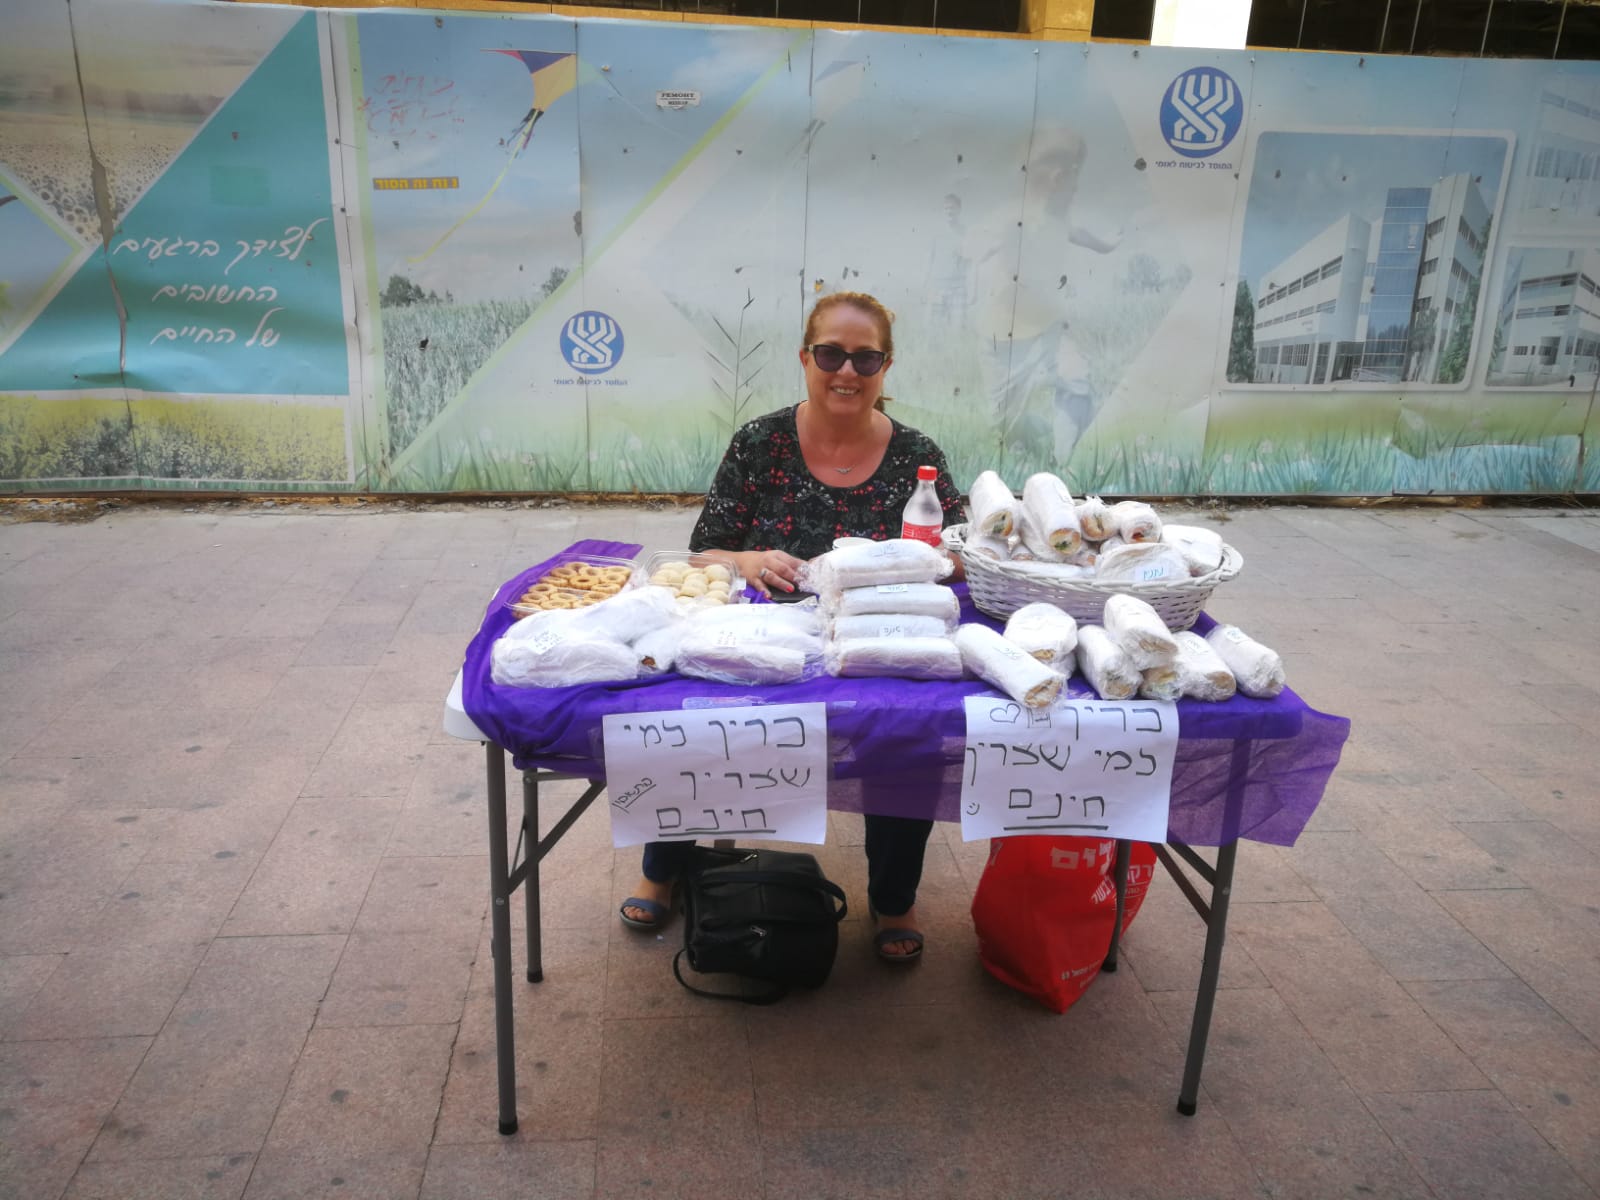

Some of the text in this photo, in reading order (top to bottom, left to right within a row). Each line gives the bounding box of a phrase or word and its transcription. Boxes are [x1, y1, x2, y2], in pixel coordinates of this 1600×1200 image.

[1155, 160, 1233, 170] המוסד לביטוח לאומי
[112, 218, 329, 275] לצידך ברגעים
[152, 284, 278, 304] החשובים
[151, 307, 286, 347] של החיים
[623, 716, 806, 761] כריך למי
[1063, 706, 1163, 741] כריך
[966, 743, 1157, 786] למי שצריך
[679, 767, 811, 801] שצריך
[656, 807, 768, 831] חינם
[1008, 788, 1106, 819] חינם
